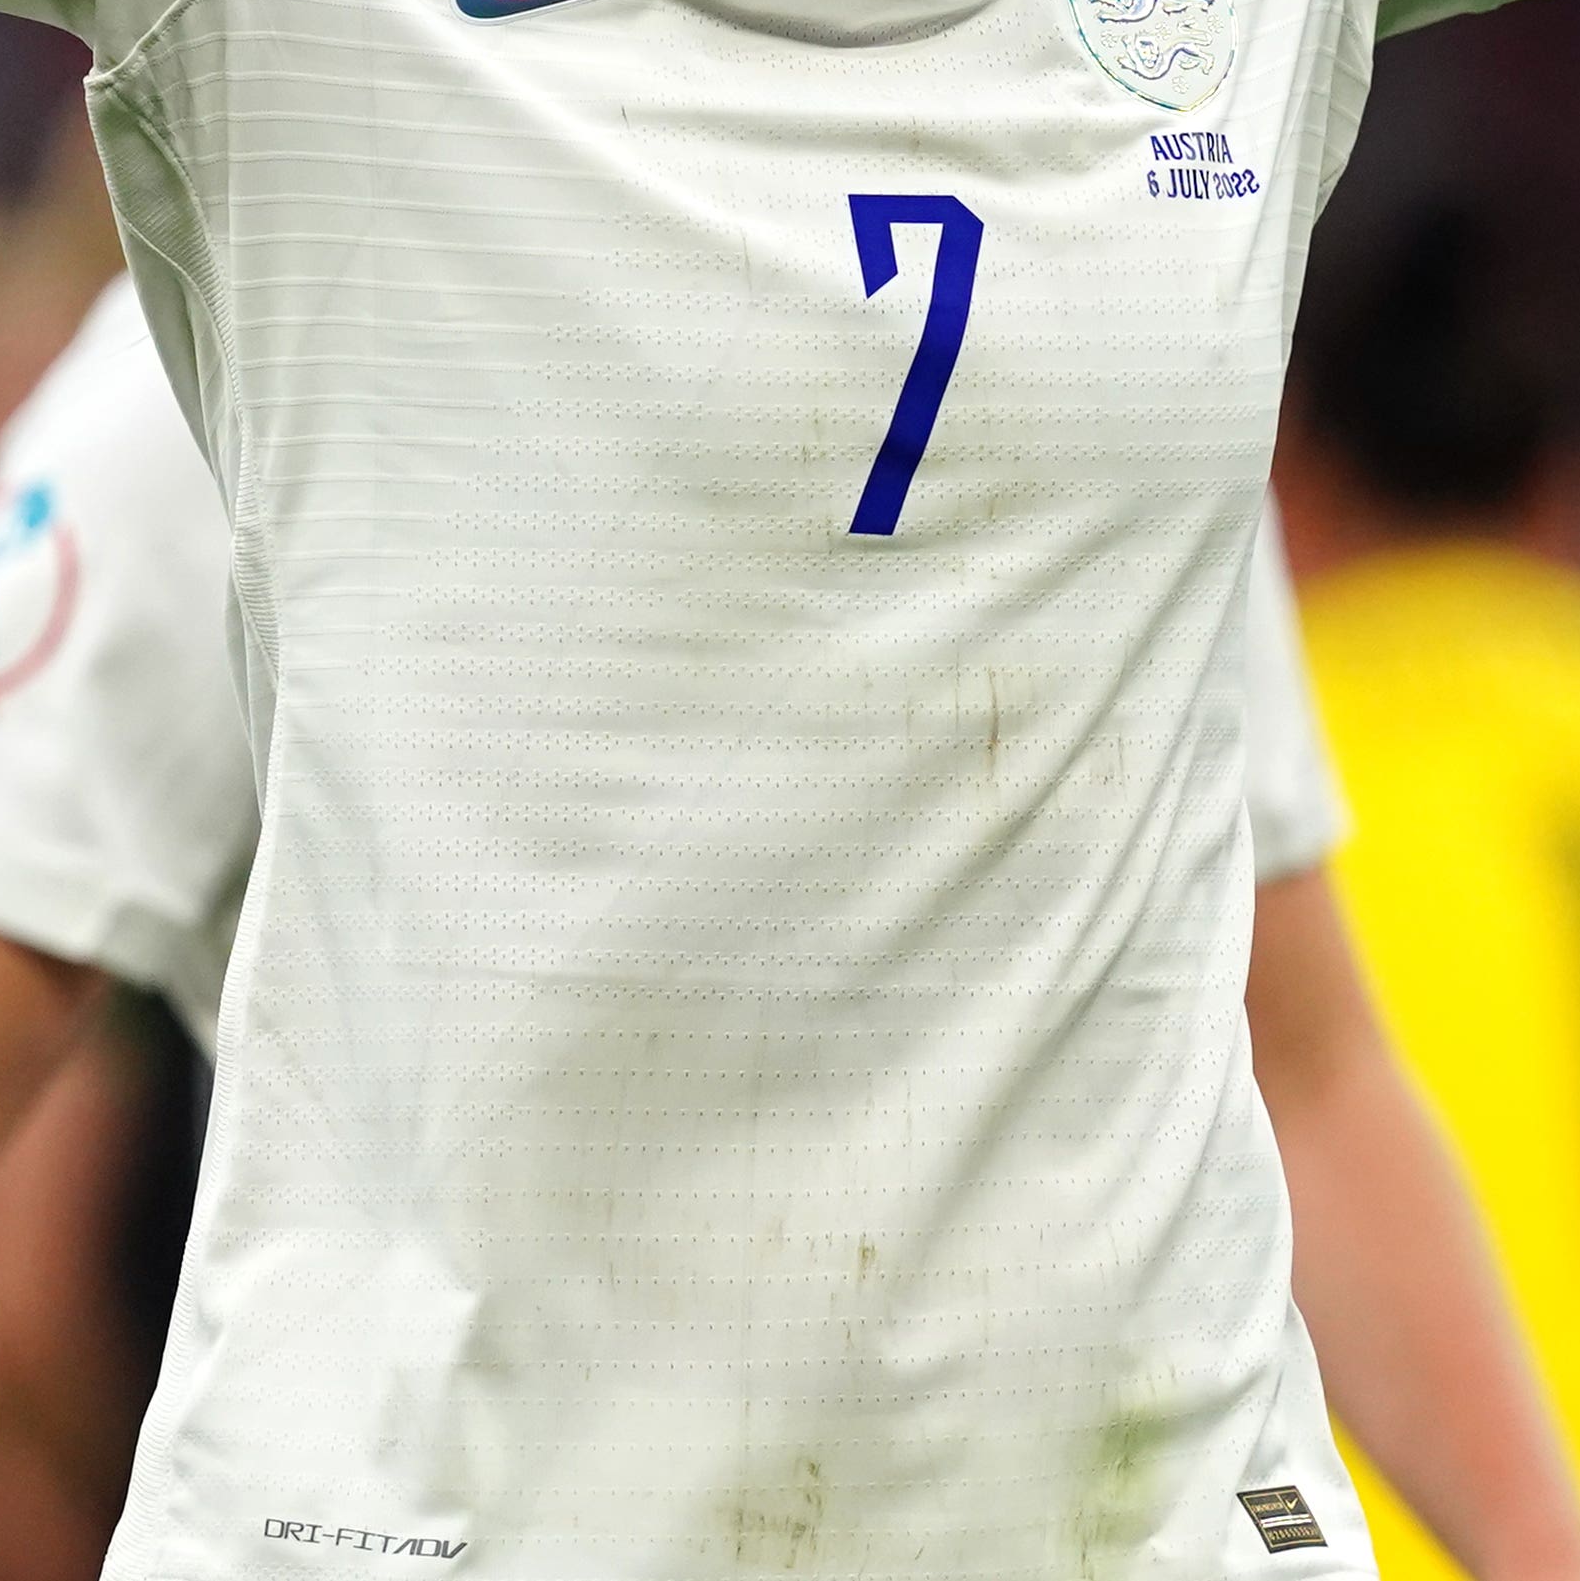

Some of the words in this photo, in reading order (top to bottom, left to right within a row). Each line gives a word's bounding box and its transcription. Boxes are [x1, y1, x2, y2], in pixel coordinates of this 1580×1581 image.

[1149, 131, 1234, 164] AUSTRIA
[1146, 169, 1160, 198] 6
[1166, 168, 1210, 200] JULY
[1212, 168, 1260, 200] 2022
[847, 193, 985, 536] 7
